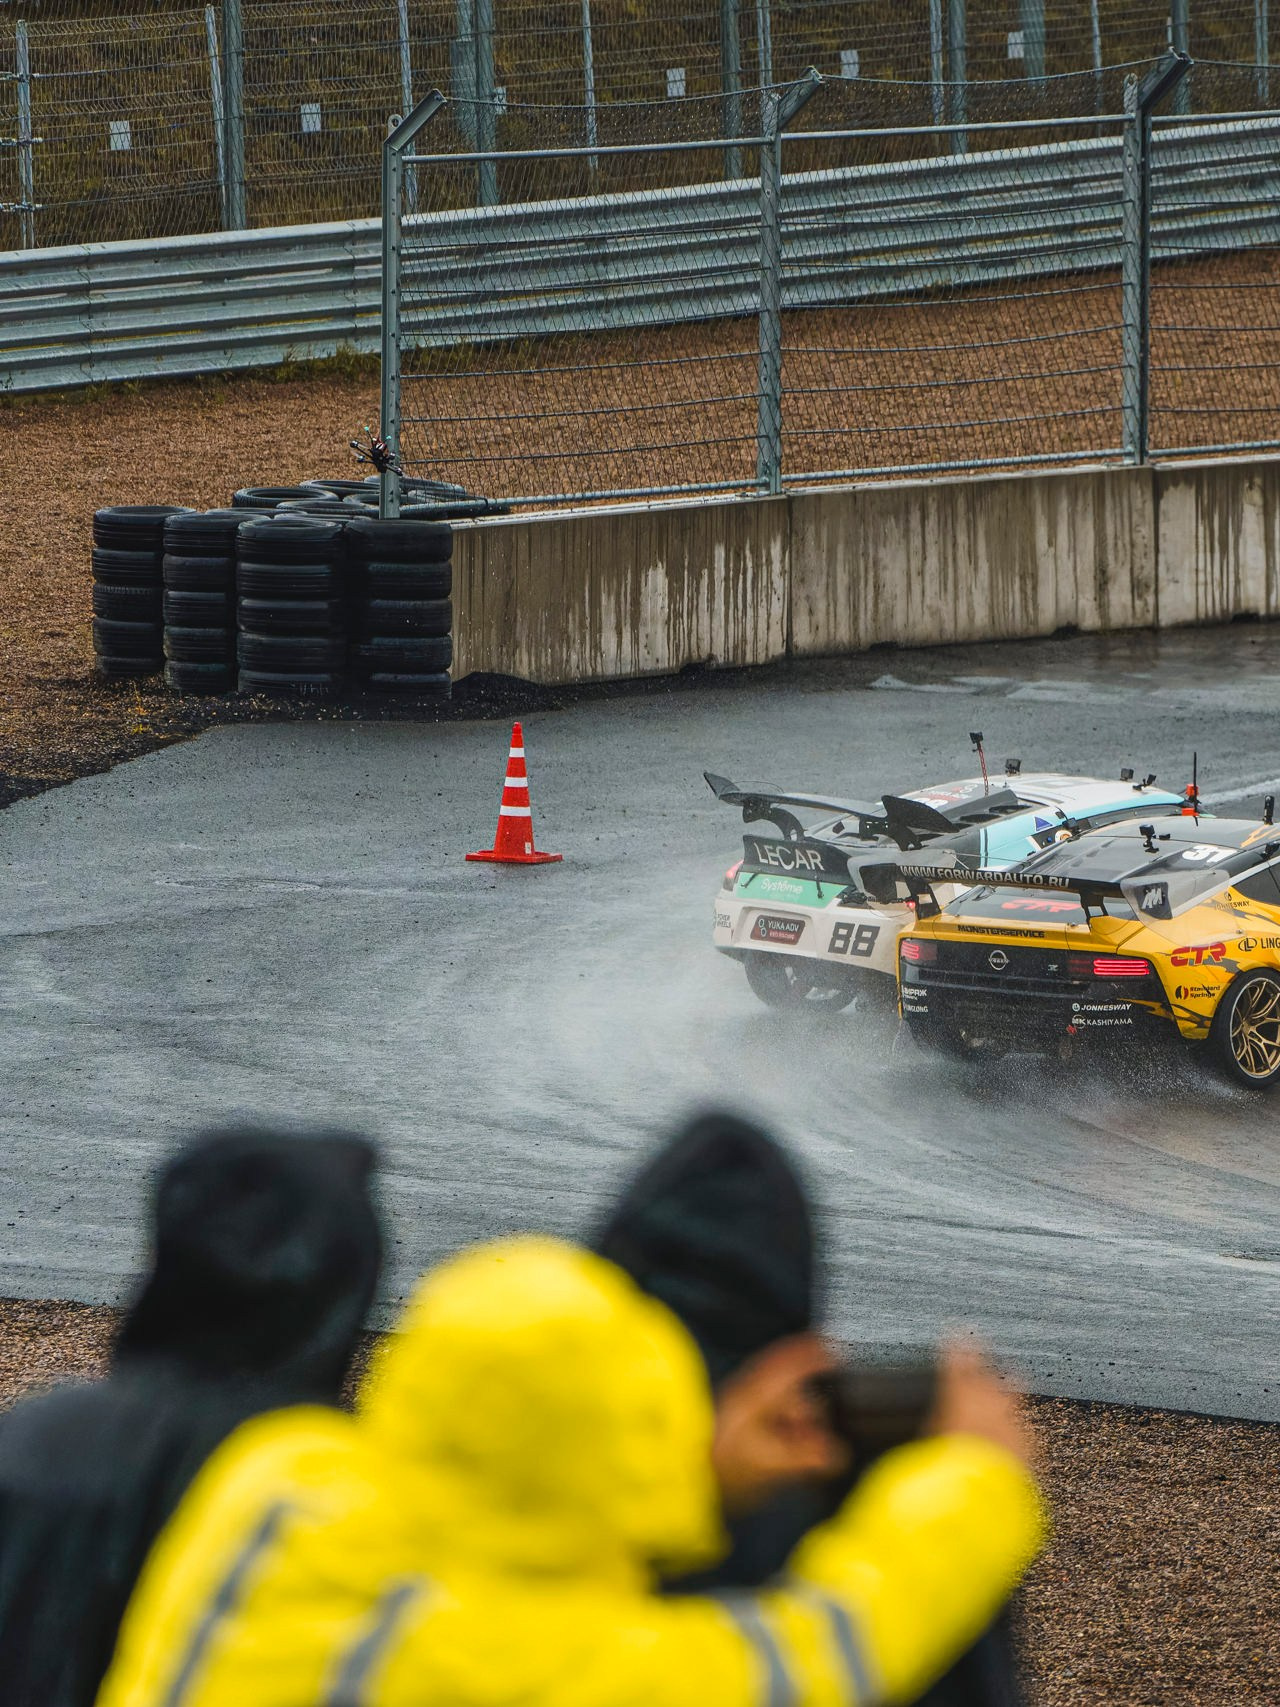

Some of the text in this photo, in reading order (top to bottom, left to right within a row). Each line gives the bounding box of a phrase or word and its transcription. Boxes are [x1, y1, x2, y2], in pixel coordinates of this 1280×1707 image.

[753, 842, 825, 870] LECAR
[1181, 845, 1238, 864] 31
[900, 865, 1070, 888] WWW.FORWARDAUTO.RU
[828, 922, 881, 957] 88
[1170, 942, 1226, 967] CTR
[1081, 1003, 1132, 1012] JONNESWAY
[1086, 1018, 1133, 1026] KASHIYAMA
